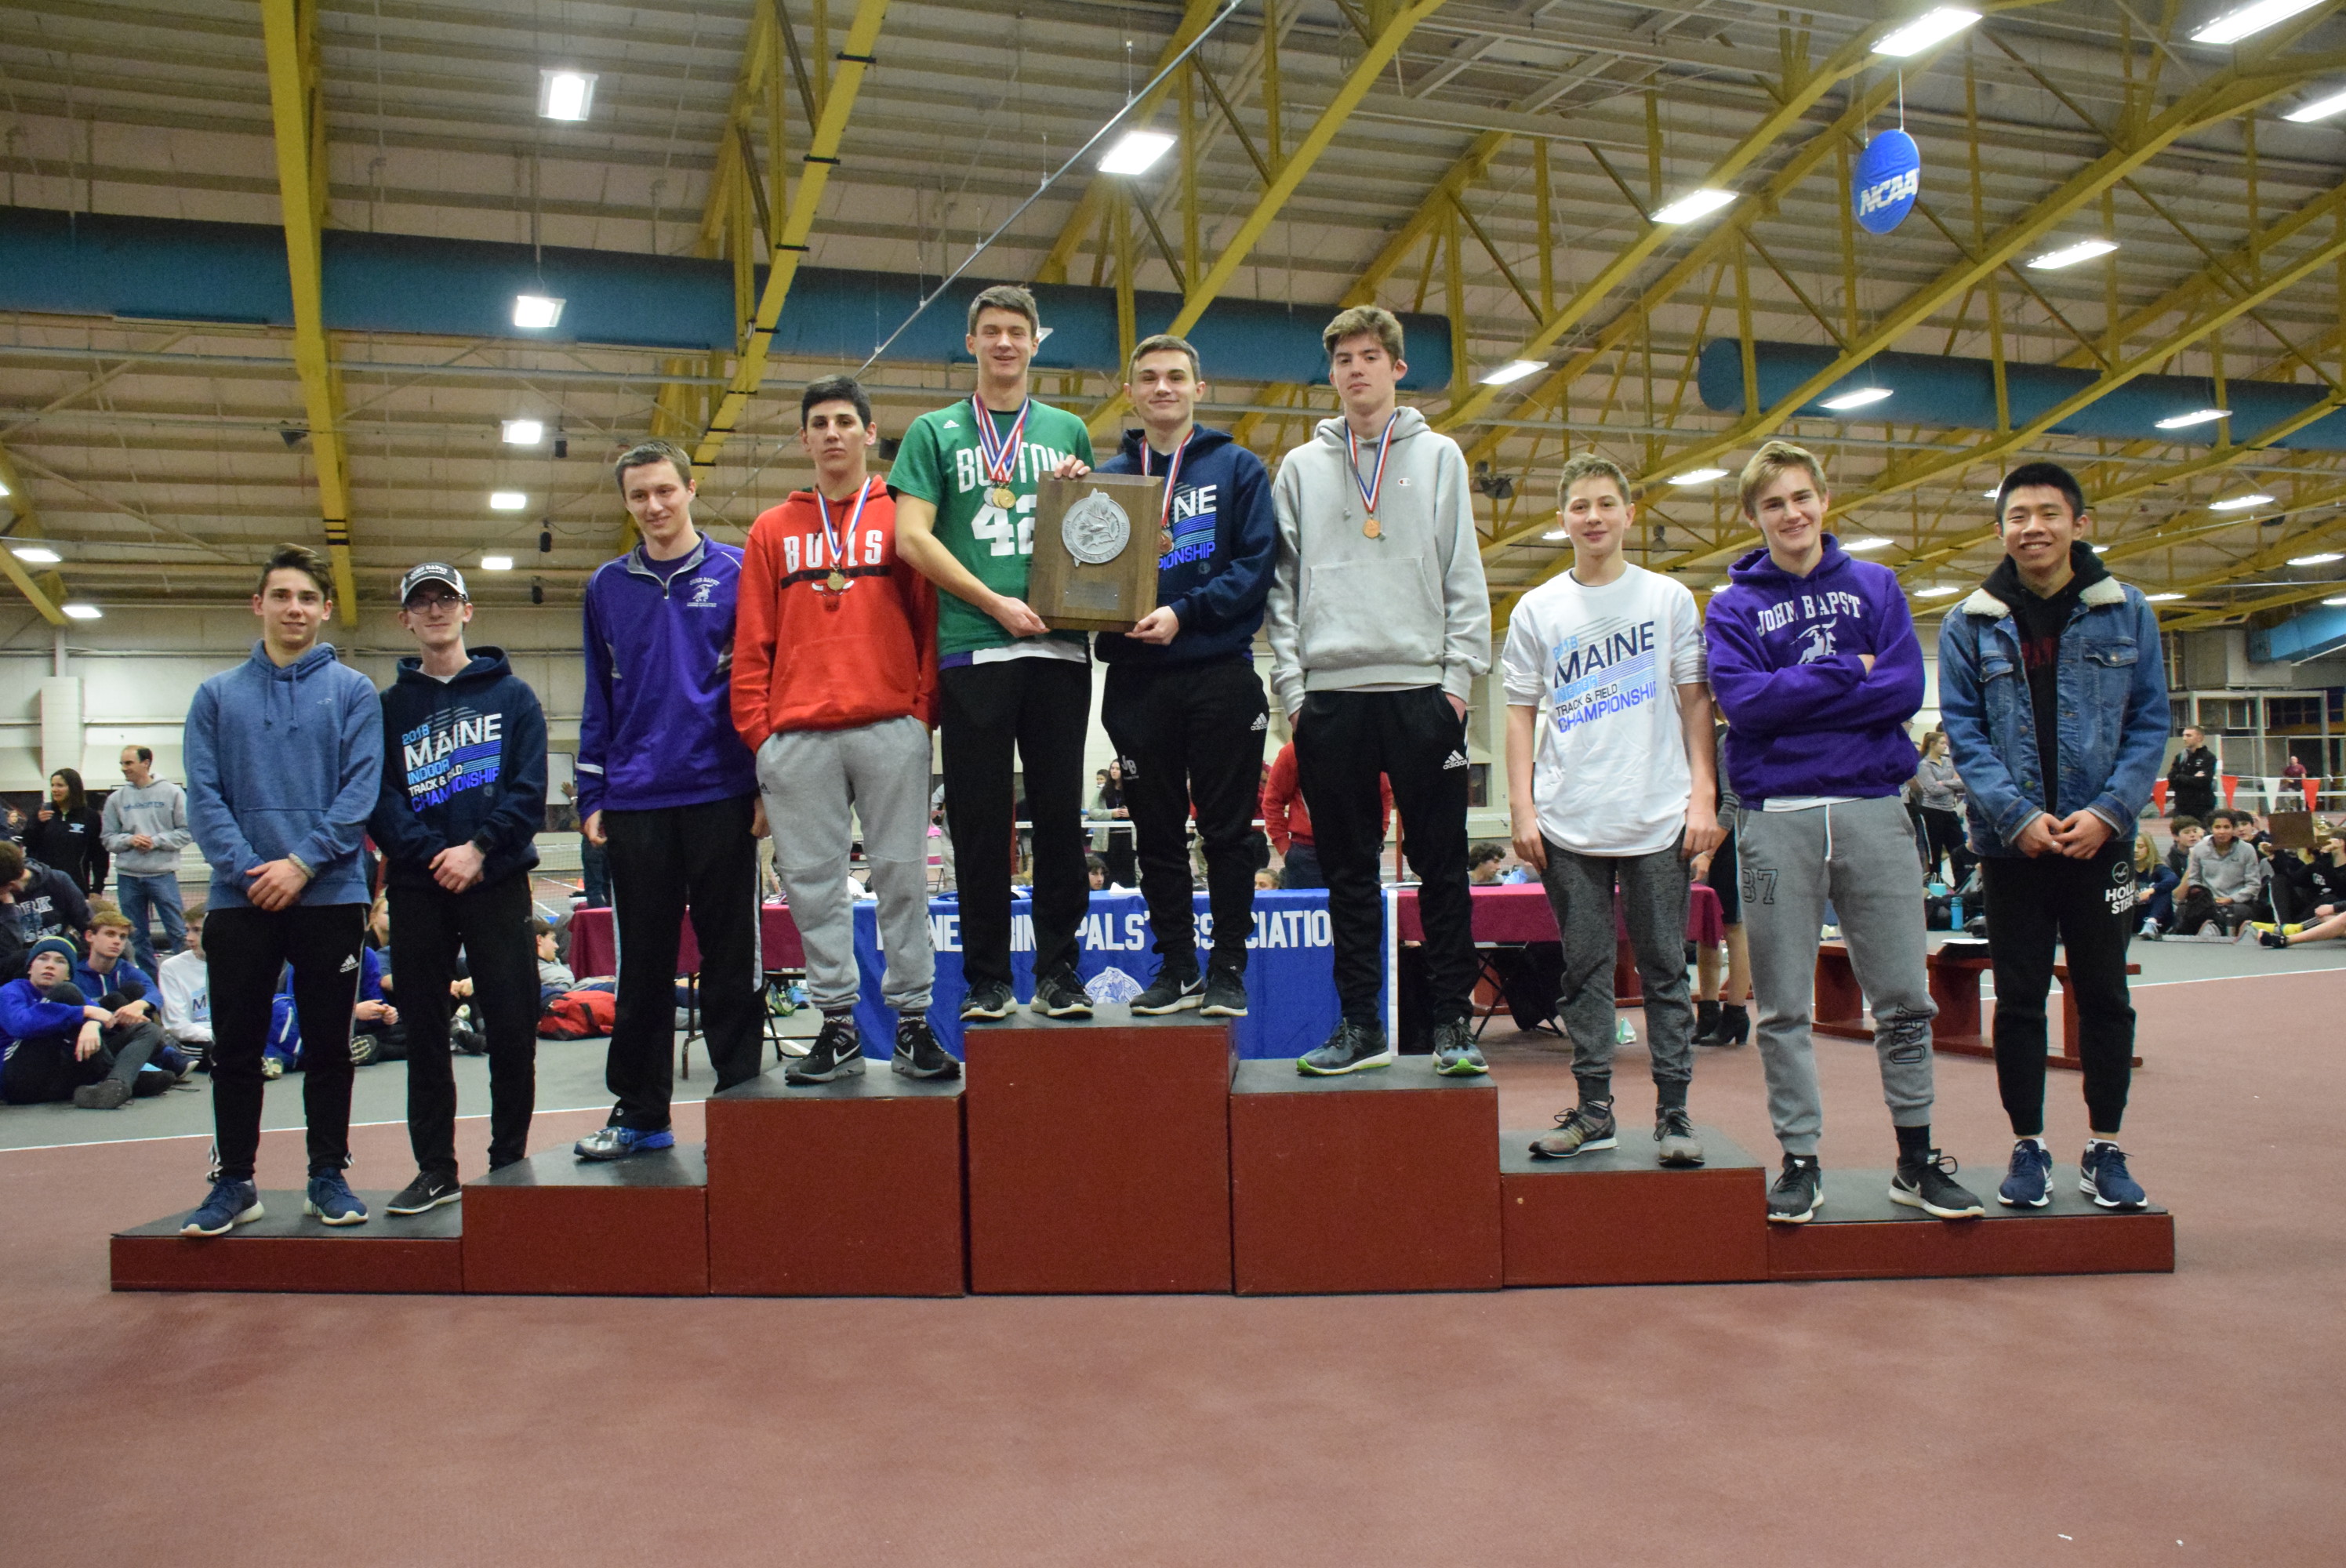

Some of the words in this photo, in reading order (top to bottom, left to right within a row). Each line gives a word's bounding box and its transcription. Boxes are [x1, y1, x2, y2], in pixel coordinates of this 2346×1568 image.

[1859, 167, 1919, 216] NCAA
[956, 441, 1066, 494] BOTON
[1756, 600, 1799, 637] JOHN
[1801, 591, 1861, 619] BAPST
[1554, 620, 1654, 689] MAINE
[1556, 696, 1583, 717] TRACK
[1585, 693, 1592, 703] &
[1594, 683, 1618, 700] FIELD
[401, 724, 430, 746] 2018
[404, 713, 502, 772] MAINE
[407, 758, 450, 785] INDOOR
[408, 779, 438, 797] TRACK
[439, 776, 447, 786] &
[1443, 758, 1467, 770] adidas
[411, 767, 500, 813] CHAMIONSHIP
